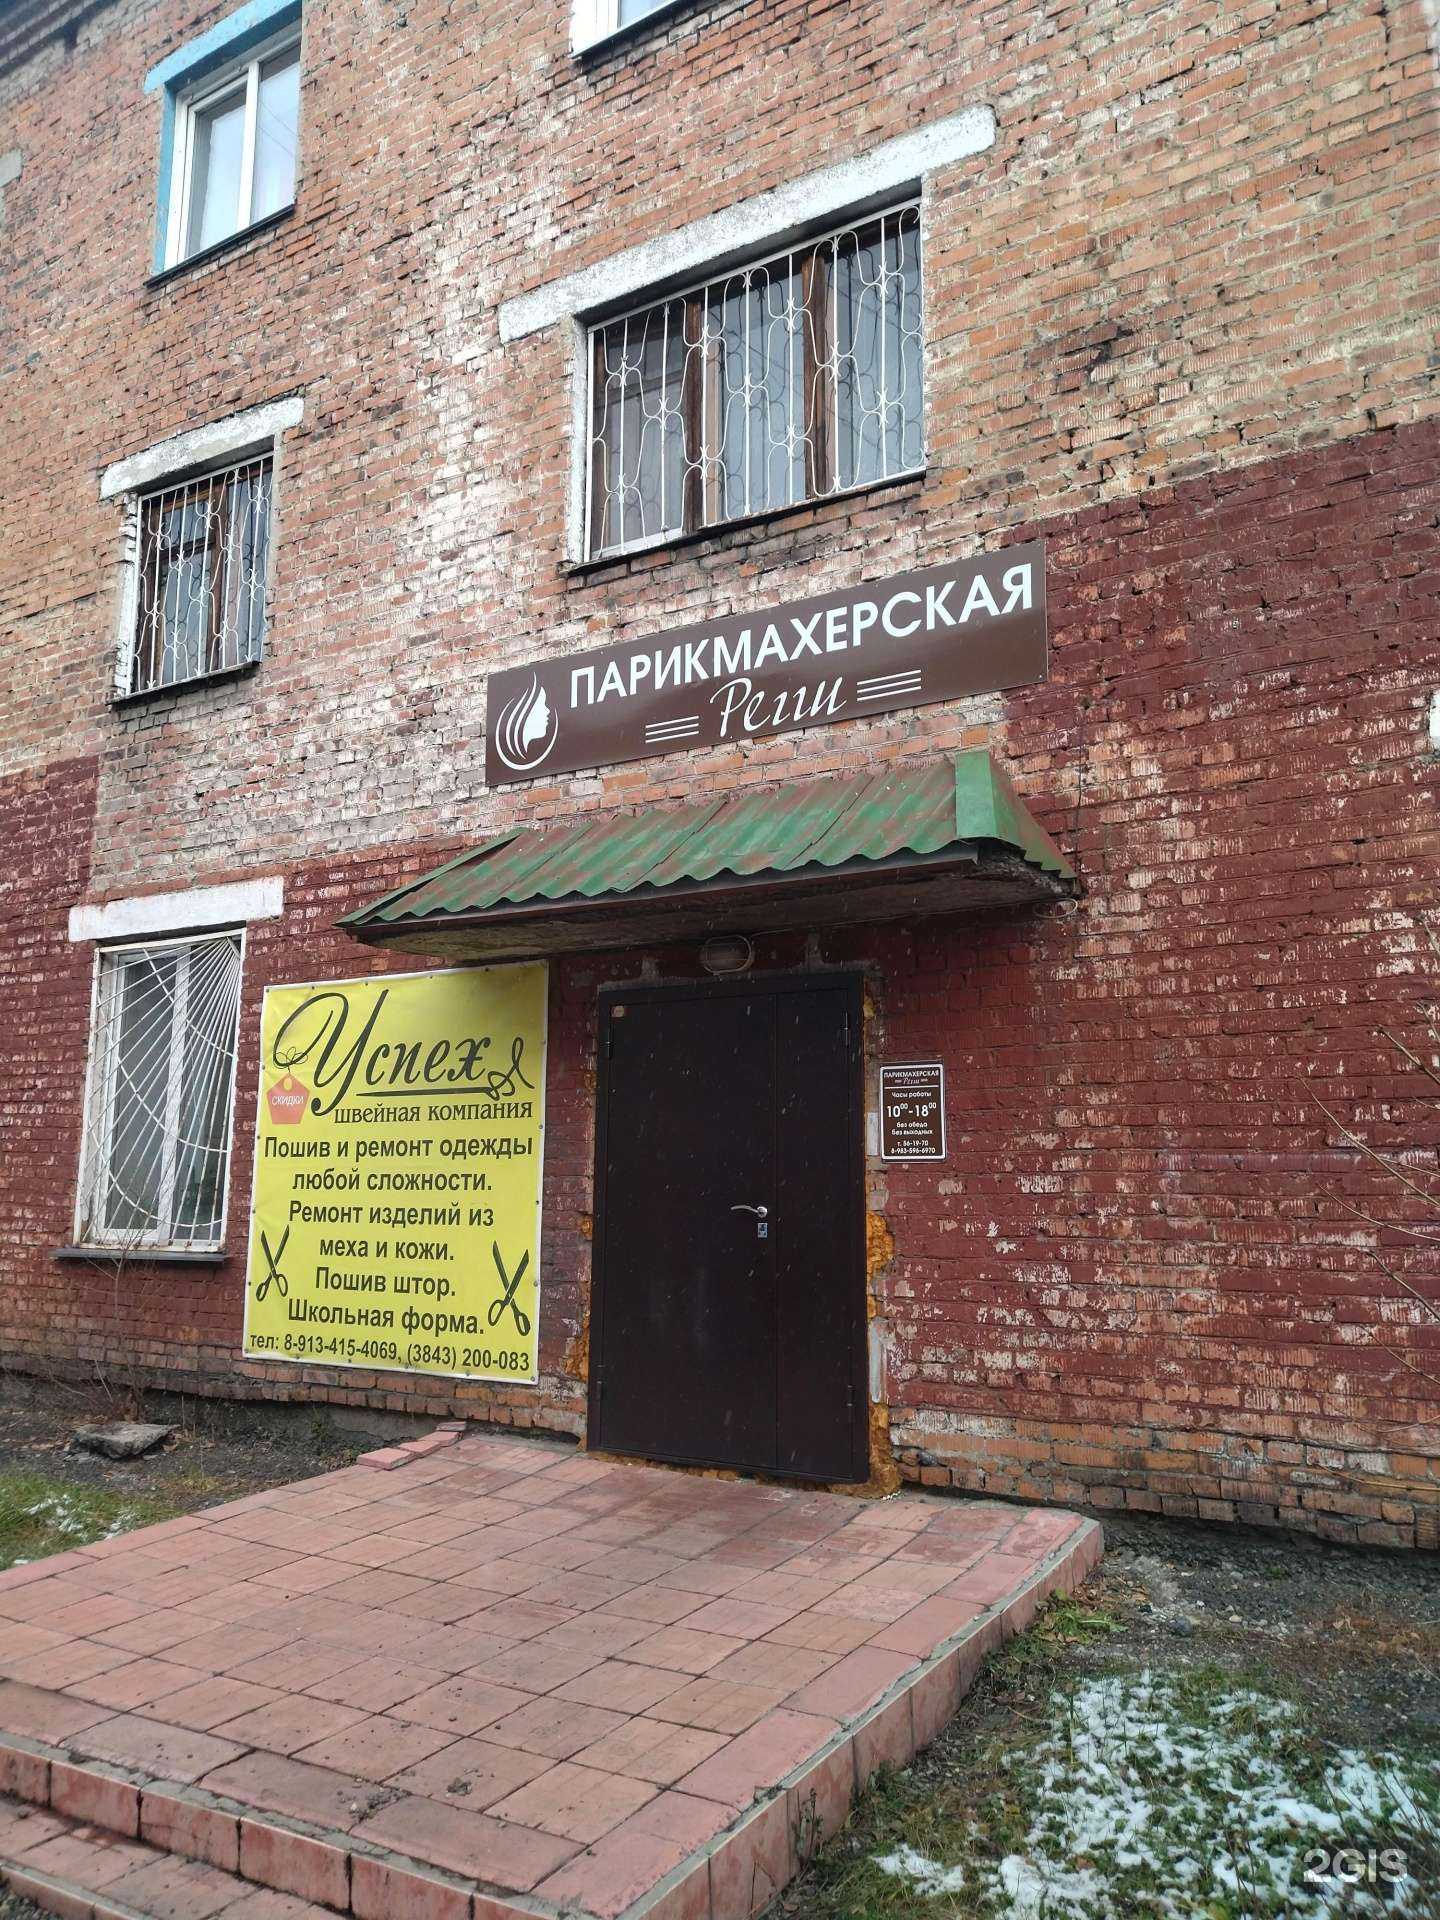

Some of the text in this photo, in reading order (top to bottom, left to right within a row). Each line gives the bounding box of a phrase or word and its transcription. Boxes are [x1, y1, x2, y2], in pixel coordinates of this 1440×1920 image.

[570, 563, 1033, 708] ПАРИКМАХЕРСКАЯ
[711, 676, 846, 737] Регги
[273, 989, 492, 1116] Успех
[883, 1070, 939, 1078] ПАРИКМАХЕРСКАЯ
[908, 1091, 931, 1099] работы
[334, 1102, 533, 1124] швейная компания
[264, 1136, 533, 1162] Пошив и ремонт одежды
[292, 1167, 492, 1192] любой сложности.
[289, 1200, 495, 1228] Ремонт изделий из
[319, 1239, 455, 1261] меха и кожи.
[315, 1266, 456, 1300] Пошив штор.
[288, 1298, 485, 1336] Школьная форма.
[250, 1333, 530, 1372] тел: 8-913-415-4069, (3843) 200-083
